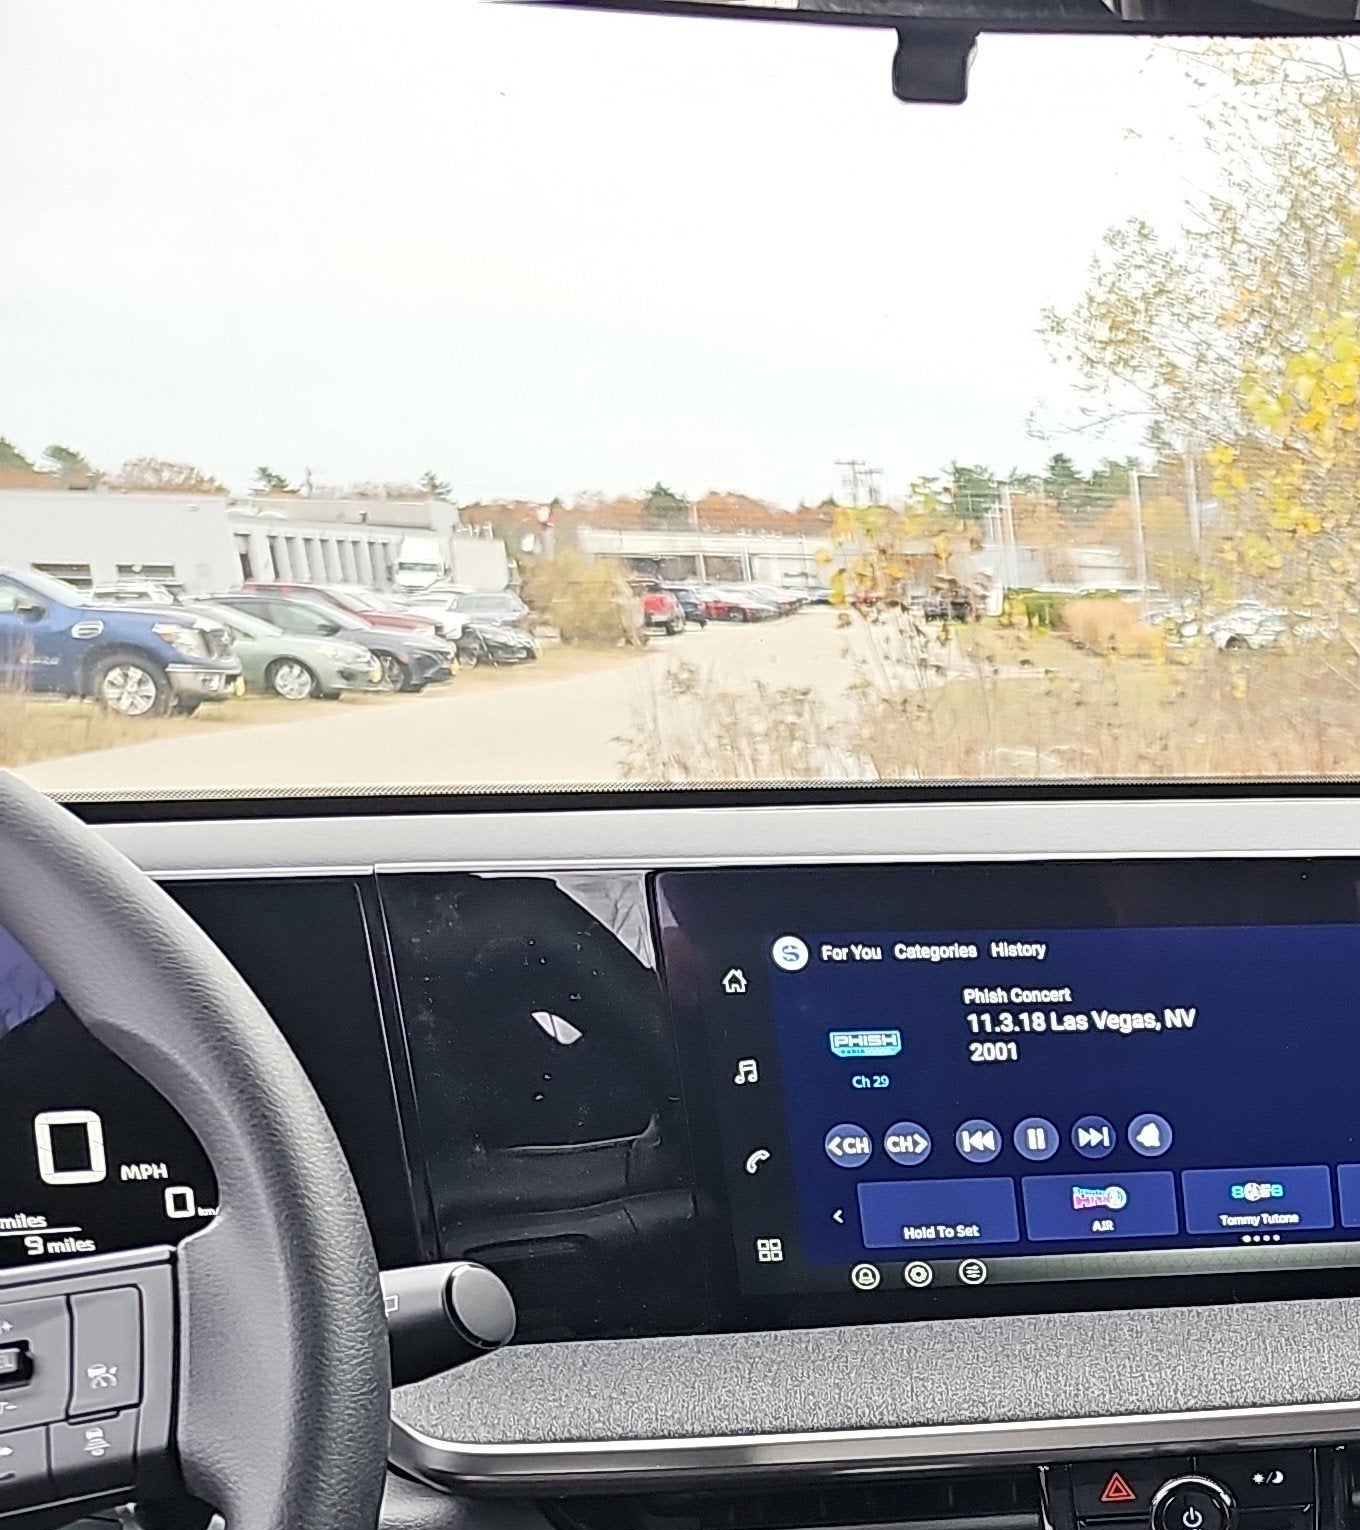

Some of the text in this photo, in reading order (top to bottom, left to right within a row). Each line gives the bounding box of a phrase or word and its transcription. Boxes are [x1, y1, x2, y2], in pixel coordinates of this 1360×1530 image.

[821, 944, 882, 961] For You
[894, 943, 978, 961] Categories
[990, 942, 1046, 960] History
[963, 987, 1074, 1004] Phish Concert
[966, 1008, 1197, 1034] 11.3.18 Las Vegas, NV
[834, 1033, 898, 1048] PHISH
[969, 1041, 1018, 1062] 2001
[852, 1074, 890, 1089] Ch 29
[34, 1109, 107, 1185] 0
[120, 1162, 169, 1181] MPH
[164, 1185, 196, 1219] 0
[0, 1212, 48, 1230] miles
[1219, 1212, 1300, 1228] Tommy Tutone
[903, 1224, 981, 1240] Hold To Set
[24, 1235, 97, 1256] 9 miles
